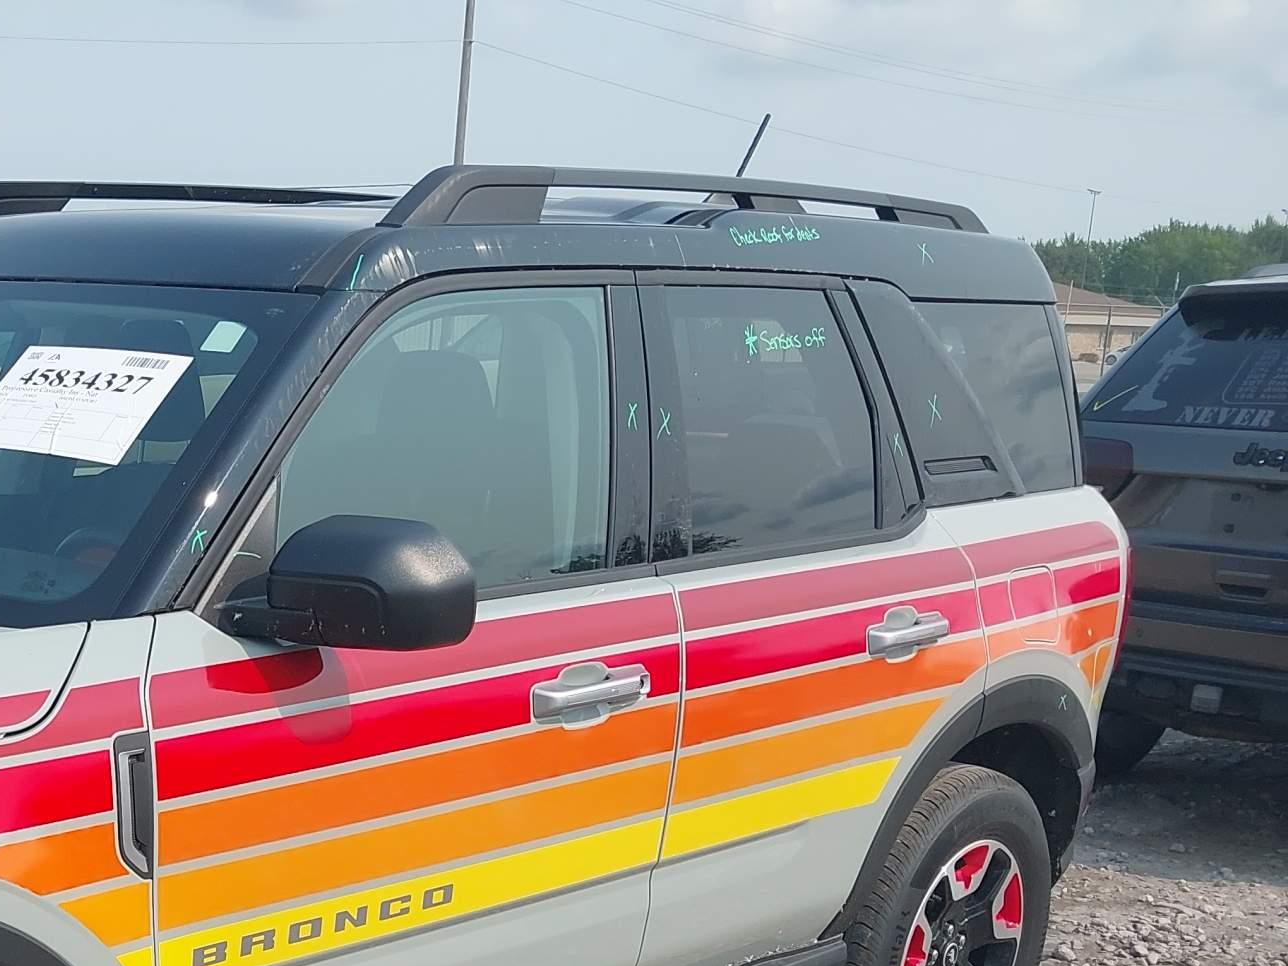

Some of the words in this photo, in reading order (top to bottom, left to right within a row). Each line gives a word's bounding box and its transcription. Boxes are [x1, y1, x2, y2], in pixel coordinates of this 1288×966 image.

[759, 330, 802, 351] Sensors
[804, 328, 826, 348] off
[20, 367, 155, 395] 45834327
[1174, 405, 1275, 428] NEVER
